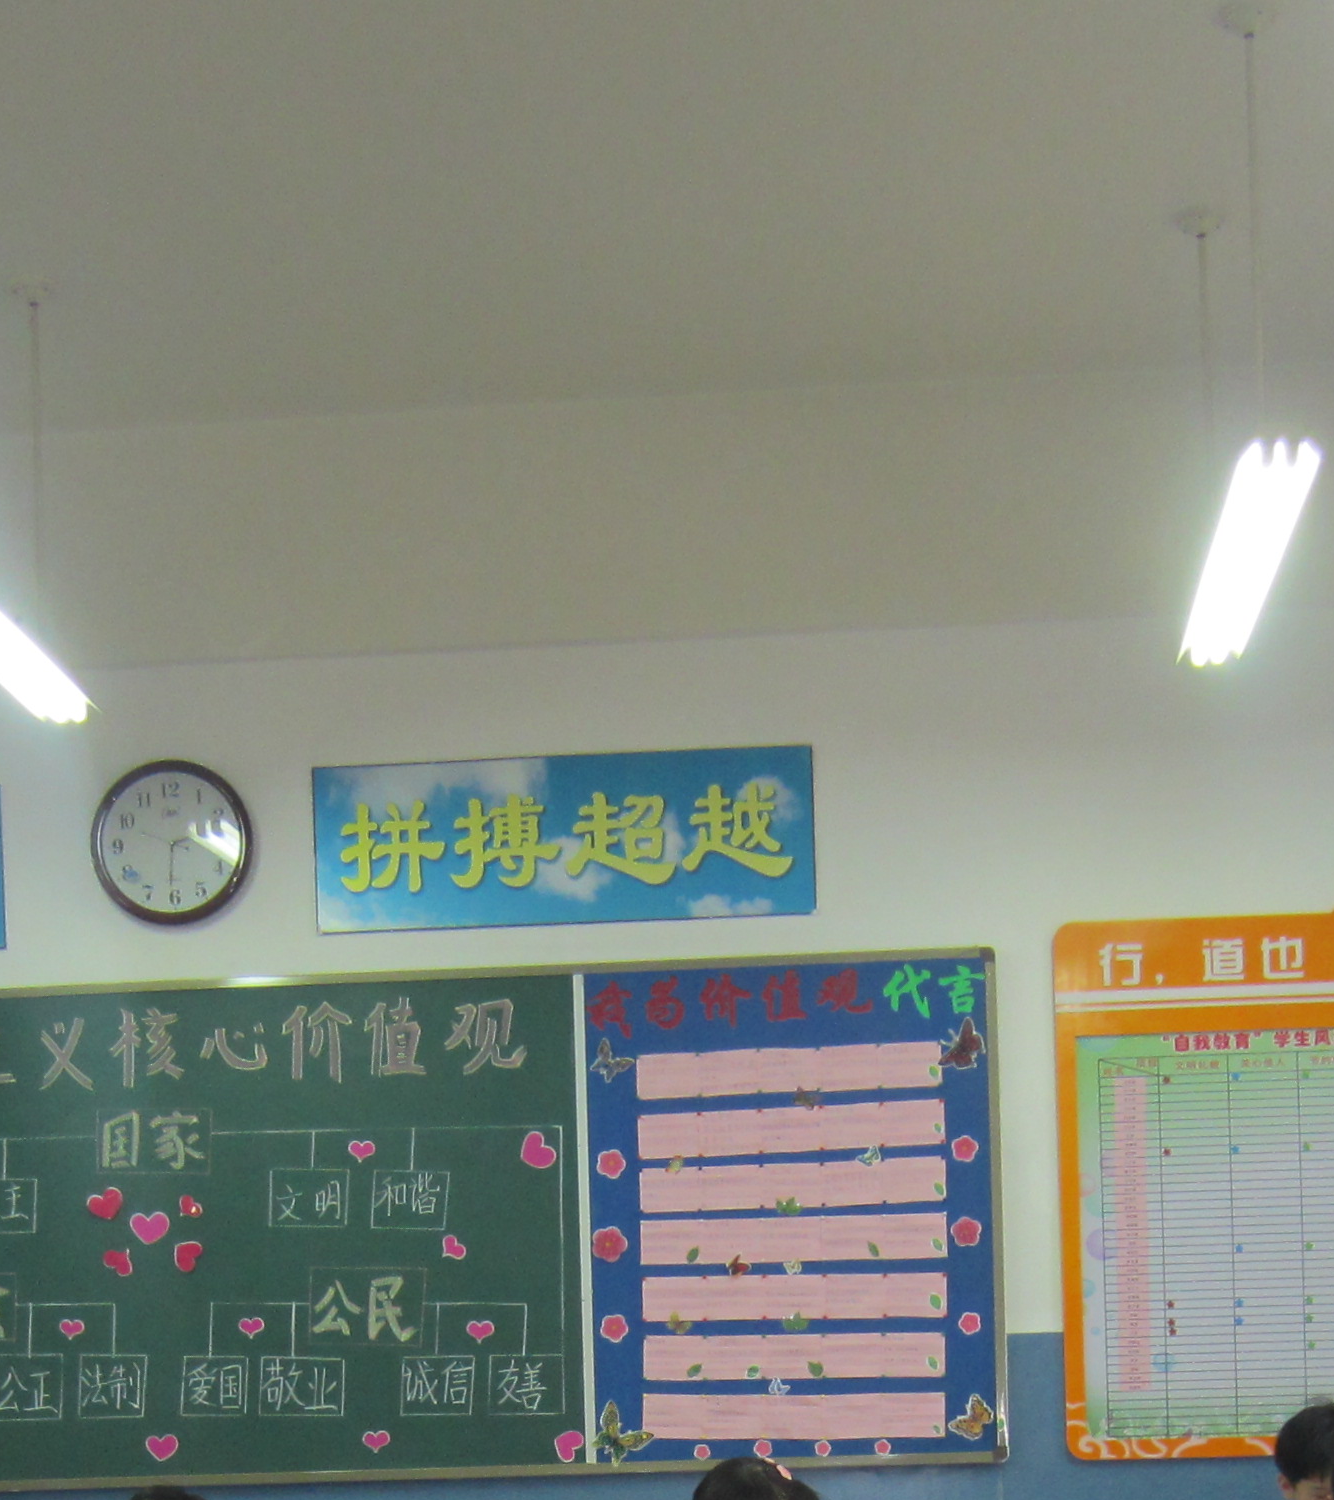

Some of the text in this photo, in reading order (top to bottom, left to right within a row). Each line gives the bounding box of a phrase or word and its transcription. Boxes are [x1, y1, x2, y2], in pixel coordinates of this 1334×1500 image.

[161, 781, 180, 798] 12
[120, 813, 135, 829] 10
[340, 783, 794, 893] 拼搏超越
[169, 889, 181, 906] 6
[101, 1110, 206, 1170] 国家
[275, 1180, 341, 1221] 文明
[375, 1172, 441, 1217] 和谐
[312, 1275, 419, 1342] 公民
[81, 1362, 141, 1410] 法制
[186, 1362, 243, 1410] 爱国
[263, 1357, 338, 1411] 敬业
[402, 1361, 474, 1405] 诚信
[497, 1359, 548, 1411] 友善
